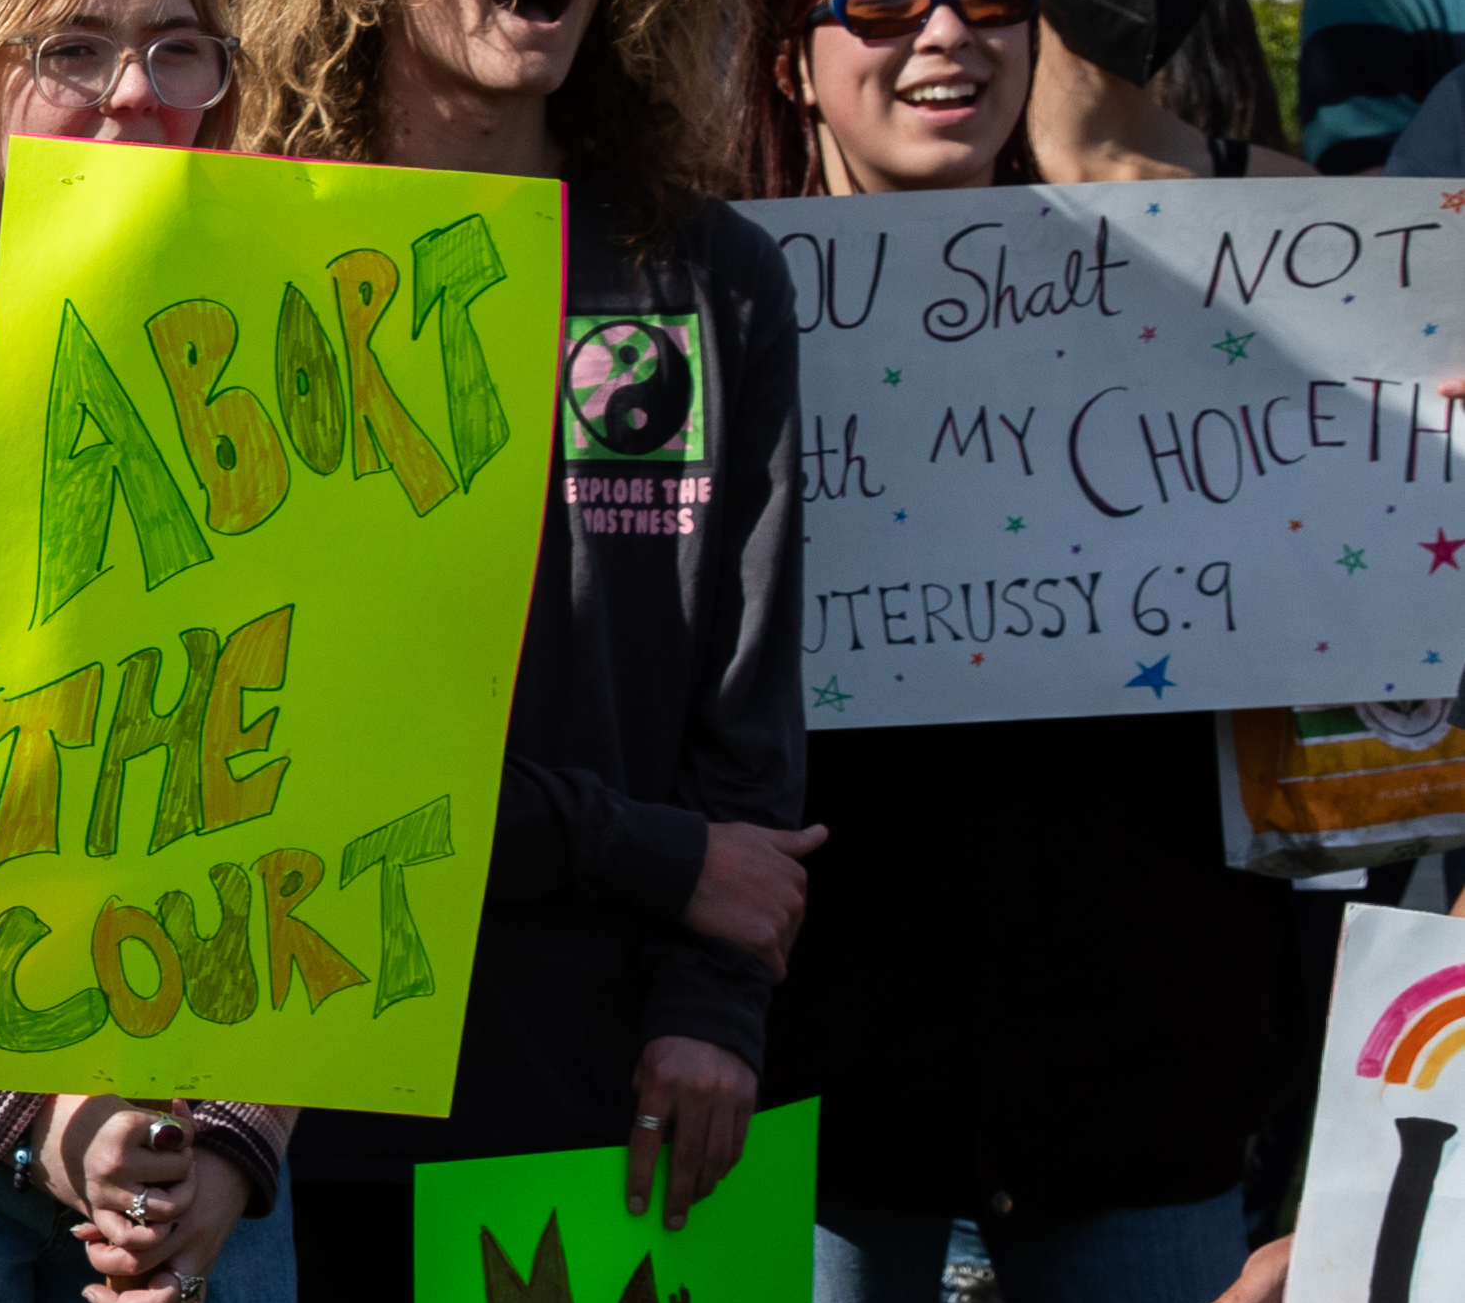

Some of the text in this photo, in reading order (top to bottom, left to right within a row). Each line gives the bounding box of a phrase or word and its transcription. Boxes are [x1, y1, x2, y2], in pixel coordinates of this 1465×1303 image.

[1204, 221, 1442, 308] NOT
[30, 212, 510, 629] ABORT
[929, 405, 1035, 477] MY
[563, 476, 713, 505] EXPLORE THE
[582, 507, 695, 535] VASTNESS
[1132, 561, 1237, 637] 6:9
